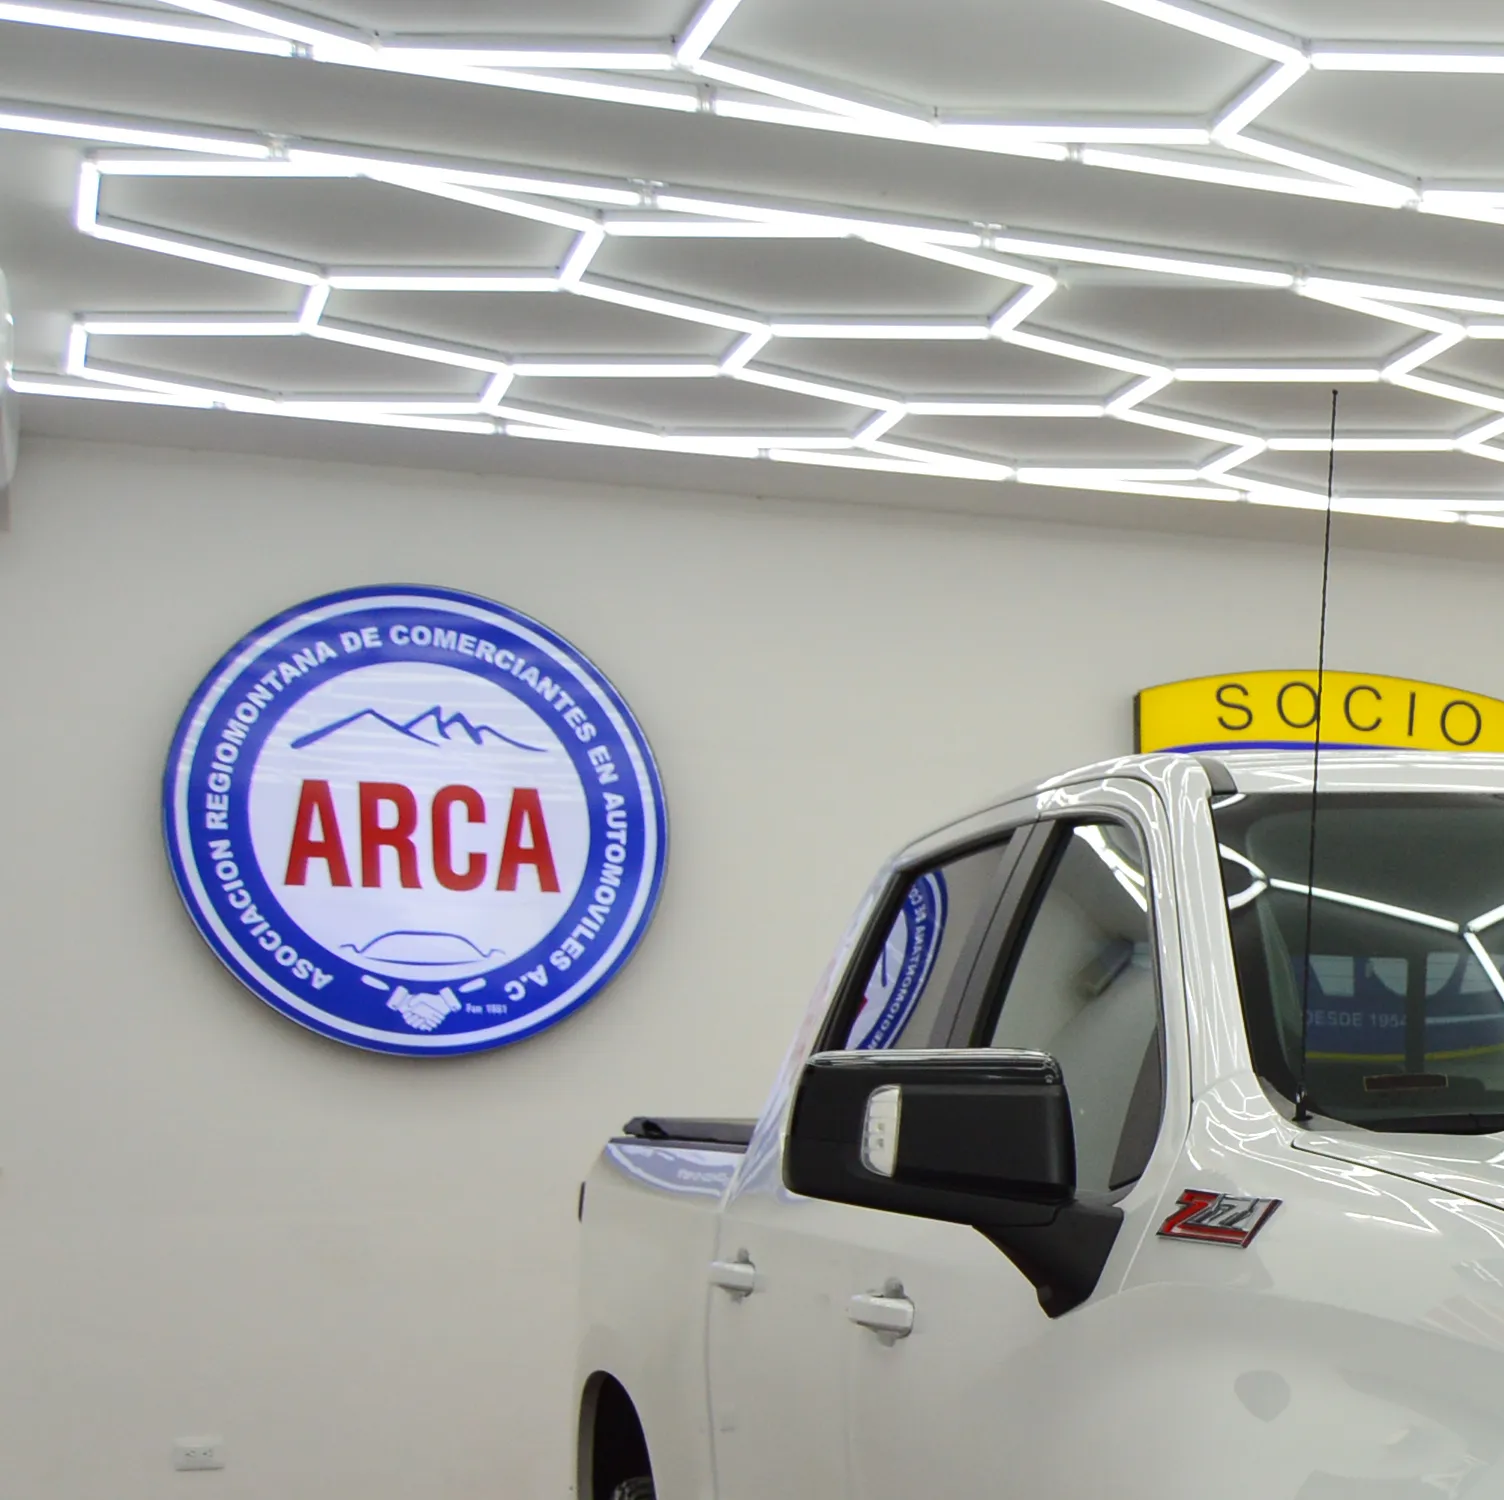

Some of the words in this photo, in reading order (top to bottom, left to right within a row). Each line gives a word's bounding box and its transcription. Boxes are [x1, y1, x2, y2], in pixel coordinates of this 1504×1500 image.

[339, 626, 383, 653] DE
[389, 624, 598, 743] COMERCIANTES
[205, 640, 338, 830] REGIOMONTANA
[587, 744, 619, 785] EN
[1214, 681, 1482, 746] SOCIO
[283, 779, 561, 893] ARCA
[549, 791, 628, 971] AUTOMOVILES
[208, 839, 334, 990] ASOCIACION
